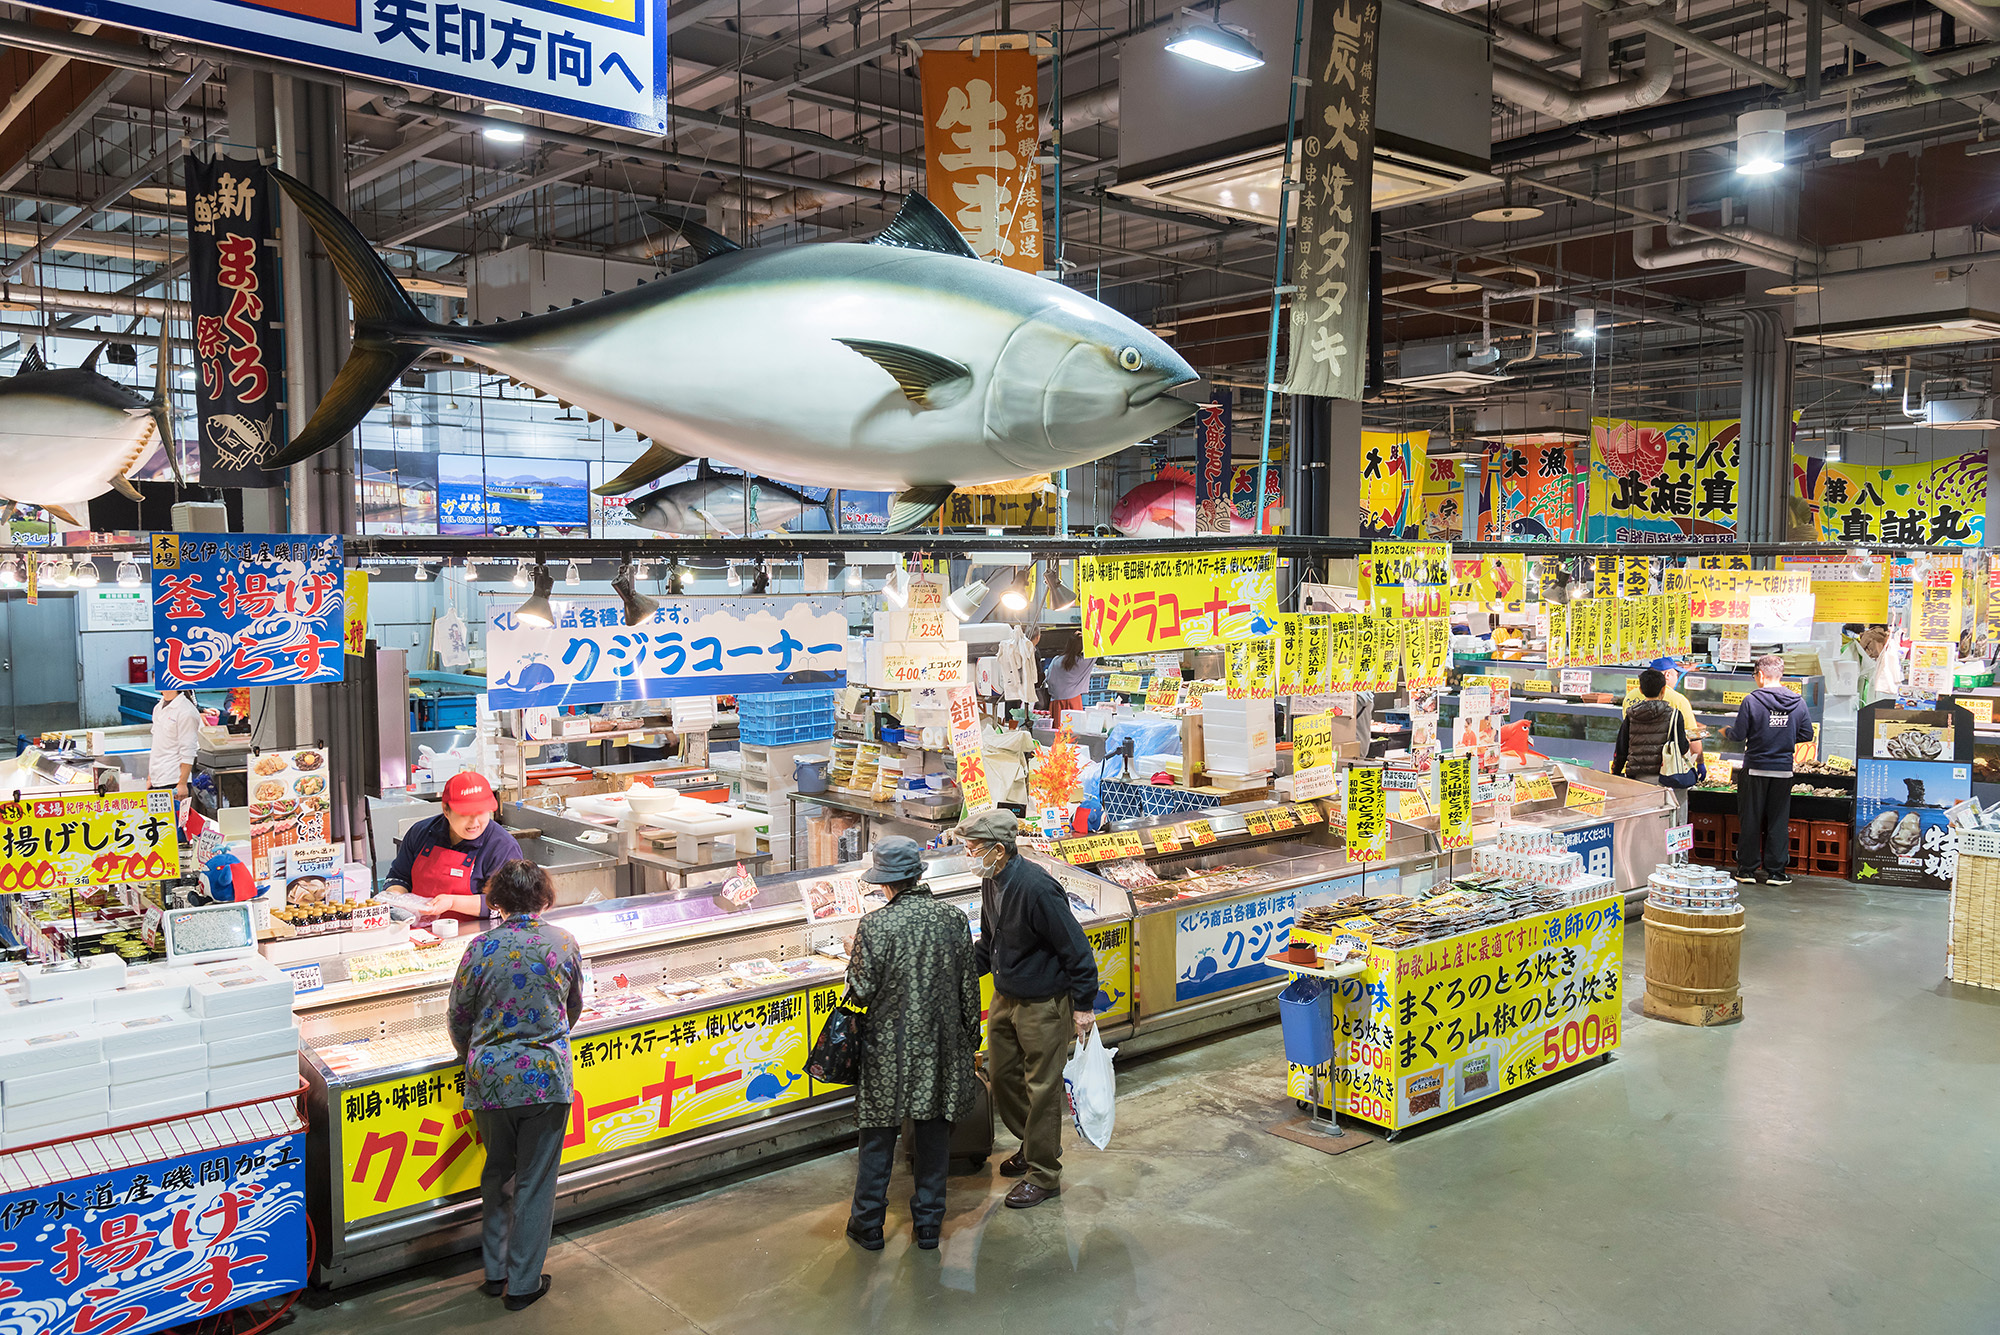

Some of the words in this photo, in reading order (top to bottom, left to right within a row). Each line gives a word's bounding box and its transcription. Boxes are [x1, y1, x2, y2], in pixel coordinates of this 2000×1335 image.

[373, 0, 645, 94] 矢印方向へ
[1013, 84, 1042, 259] 南紀勝浦港直送
[216, 232, 270, 404] まぐろ
[196, 314, 228, 401] 祭り
[1503, 448, 1567, 479] 大漁
[1822, 476, 1886, 507] 第八
[931, 493, 1057, 524] 魚コーナー
[1837, 504, 1972, 545] 真誠丸
[155, 537, 177, 567] 本場
[180, 542, 343, 563] 紀伊水道産磯間加工
[1375, 559, 1448, 585] まぐろのとろ炊き
[154, 572, 338, 619] 釜揚げ
[1402, 593, 1441, 618] 500
[1085, 586, 1251, 648] クジラコーナー
[165, 634, 341, 682] しらす
[562, 628, 843, 682] クジラコーナー
[1283, 621, 1296, 666] 鯨すじ
[895, 667, 920, 681] 400
[938, 670, 957, 681] 500
[1231, 642, 1243, 679] とろ炊き
[951, 696, 976, 724] 会計
[1769, 718, 1788, 726] 2017
[1293, 731, 1332, 751] 鯨のコロ
[959, 756, 985, 784] 氷
[66, 798, 147, 815] 紀伊水道産磯間加工
[971, 785, 987, 801] 200
[1348, 779, 1358, 811] 和歌山県
[1357, 769, 1376, 839] まぐろのとろ炊き
[1448, 760, 1462, 827] まぐろ山椒とろ炊き
[1497, 793, 1512, 803] 600
[35, 802, 64, 817] 本場
[1278, 819, 1291, 830] 600
[1409, 806, 1424, 818] 240
[2, 816, 169, 859] 揚げしらす
[1199, 832, 1212, 845] 600
[1255, 823, 1269, 834] 600
[1443, 834, 1464, 849] 500
[1074, 852, 1091, 864] 500
[1100, 847, 1116, 860] 500
[1126, 843, 1141, 856] 500
[1348, 847, 1374, 862] 500
[74, 875, 90, 886] 3箱
[91, 850, 166, 884] 2700
[738, 886, 758, 901] 600
[353, 904, 389, 919] 湯浅醤油
[1181, 893, 1297, 933] くじら商品各種あります
[1543, 901, 1623, 948] 漁師の味
[1396, 927, 1539, 985] 和歌山土産に最適です!!
[1398, 946, 1578, 1026] まぐろのとろ炊き
[1398, 969, 1620, 1069] まぐろ山椒のとろ炊き
[1350, 1039, 1384, 1071] 500
[1504, 1055, 1537, 1087] 各1袋
[1542, 1013, 1601, 1073] 500
[1600, 1022, 1618, 1051] 円
[1349, 1090, 1384, 1123] 500
